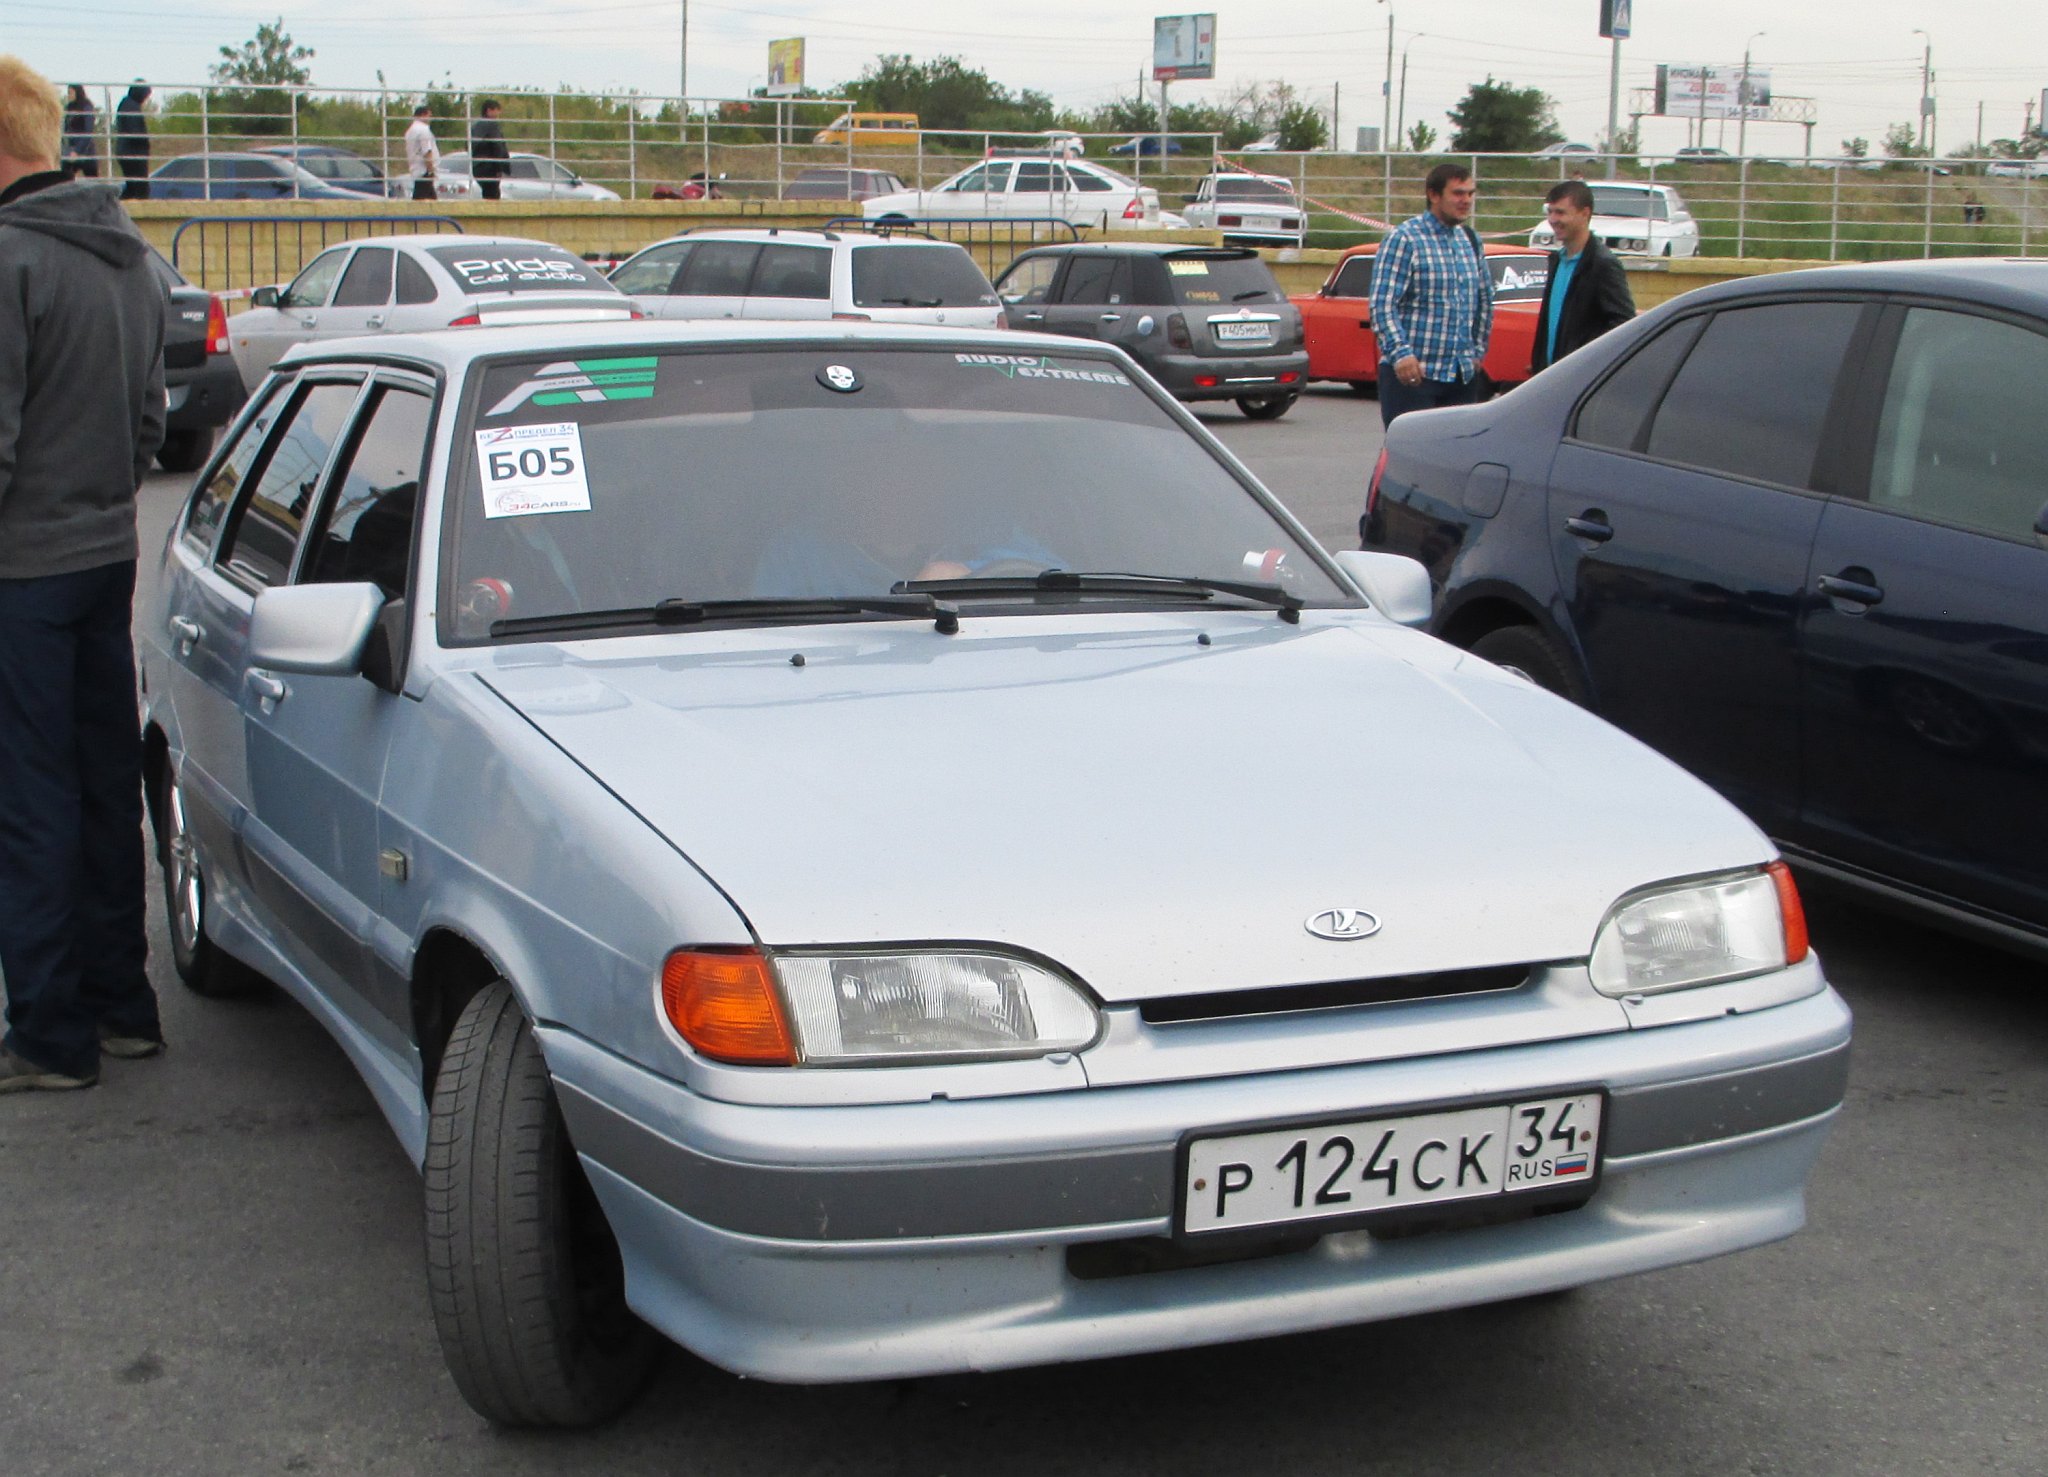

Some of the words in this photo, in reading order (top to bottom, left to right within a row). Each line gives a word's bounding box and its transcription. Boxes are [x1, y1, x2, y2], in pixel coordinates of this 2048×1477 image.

[453, 258, 575, 277] Pride
[469, 273, 509, 285] car
[518, 271, 587, 282] audio
[955, 353, 1038, 366] AUDIO
[1017, 367, 1131, 386] EXTREME
[489, 446, 575, 481] Б05
[1517, 1102, 1578, 1158] 34
[1508, 1159, 1553, 1184] RUS
